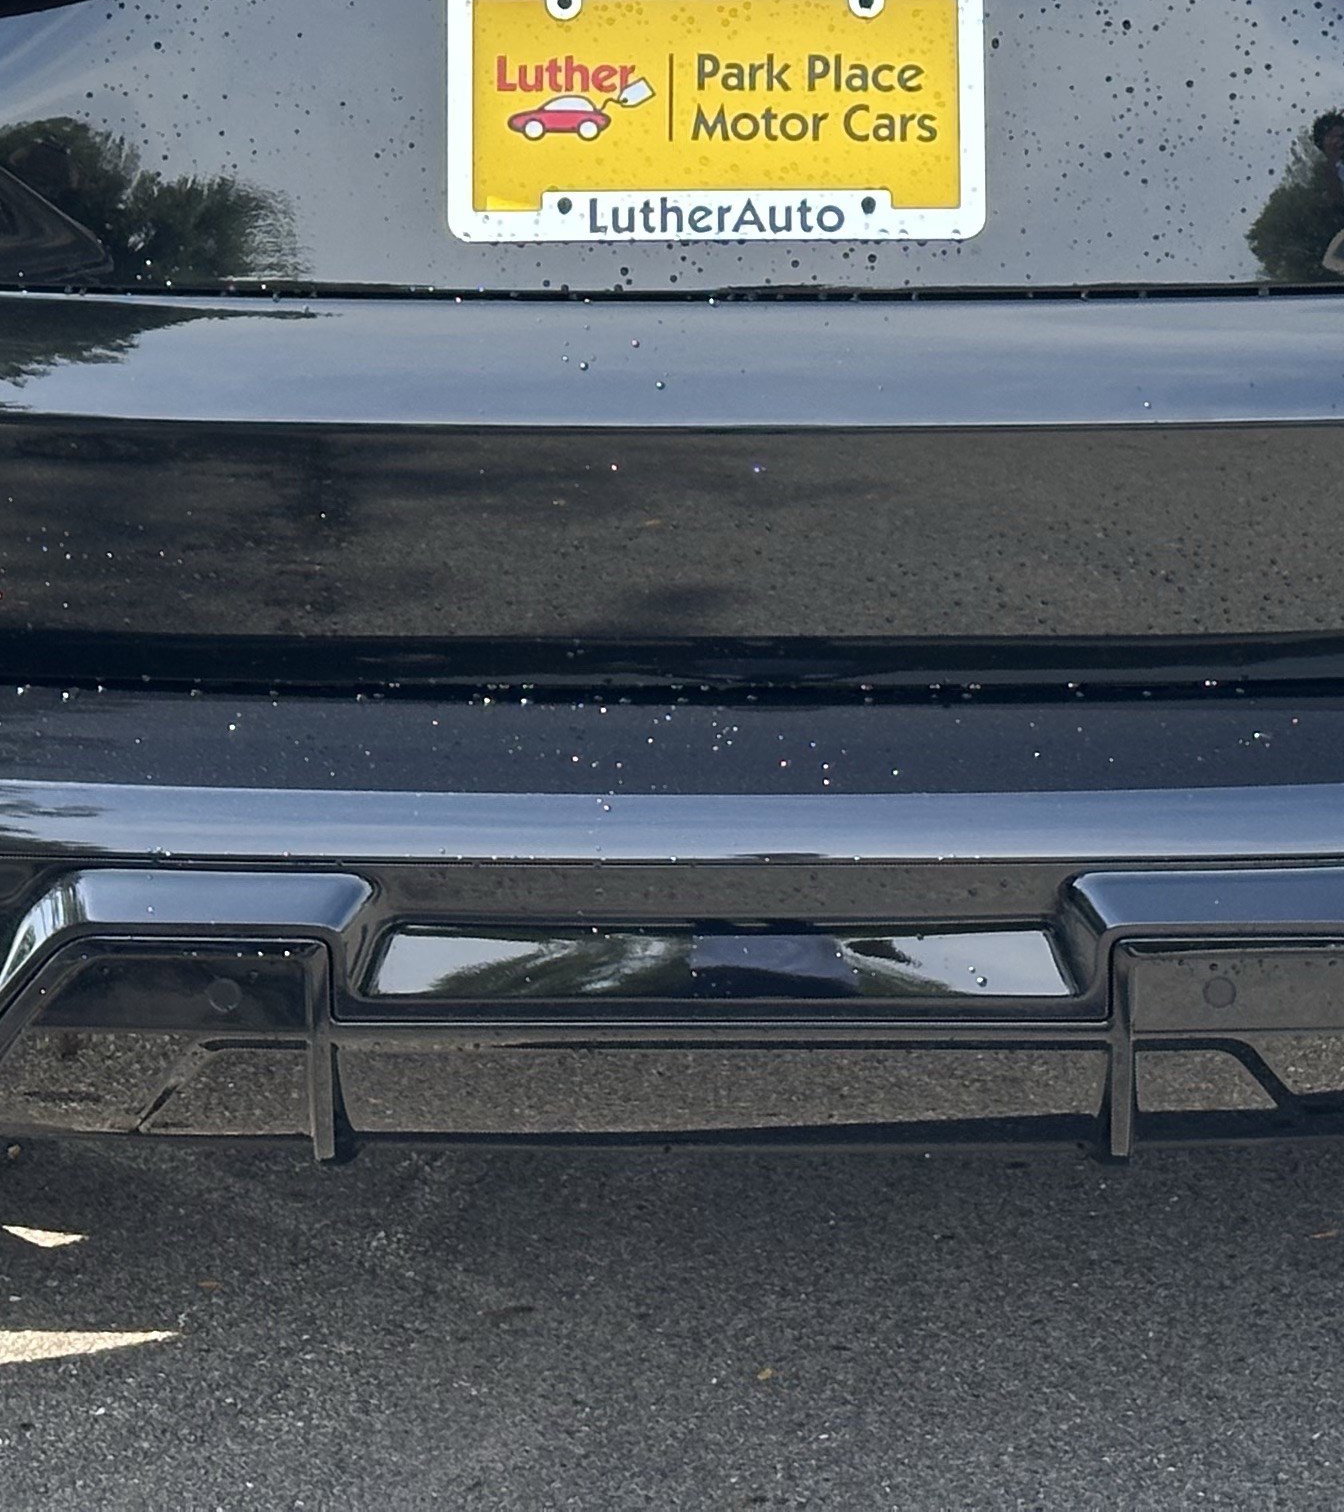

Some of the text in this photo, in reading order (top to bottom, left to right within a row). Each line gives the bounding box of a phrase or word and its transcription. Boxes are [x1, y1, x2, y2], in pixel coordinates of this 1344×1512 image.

[496, 54, 636, 93] Luther
[696, 53, 925, 92] Park Place
[691, 104, 938, 143] Motor Cars
[589, 197, 845, 235] LutherAuto
